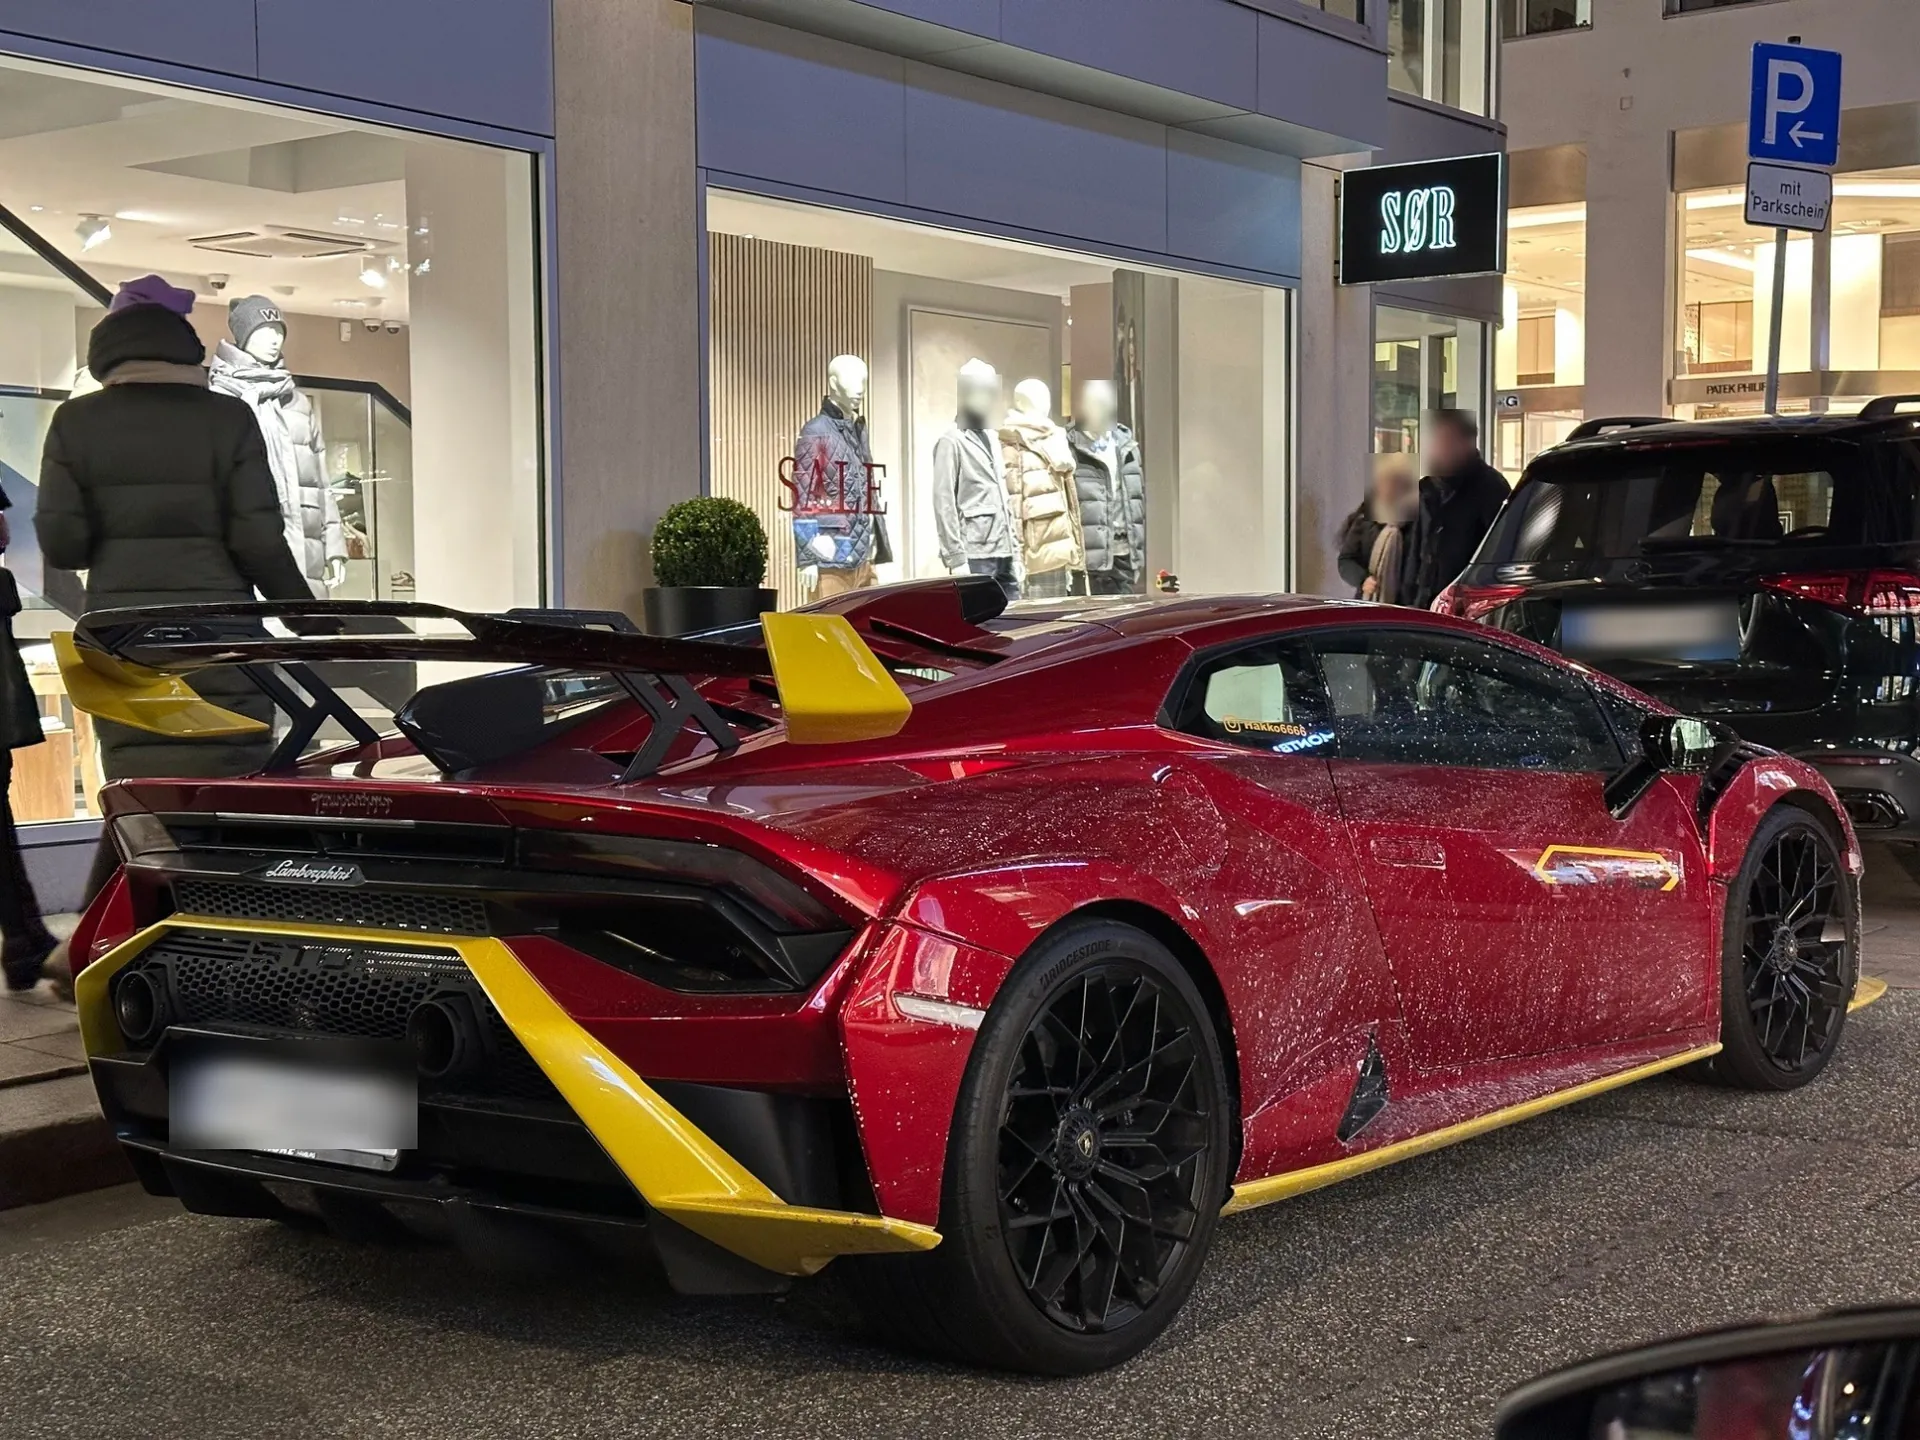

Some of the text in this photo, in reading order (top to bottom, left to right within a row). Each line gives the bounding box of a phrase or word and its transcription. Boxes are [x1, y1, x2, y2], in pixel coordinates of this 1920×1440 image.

[1764, 58, 1814, 145] P
[1780, 180, 1802, 197] mit
[1752, 195, 1825, 219] Parkschein
[1380, 186, 1457, 254] SØR
[260, 308, 281, 322] W
[1706, 383, 1736, 395] PATEK
[777, 456, 888, 515] SALE
[266, 860, 355, 883] Lamborghini
[252, 942, 353, 969] STO
